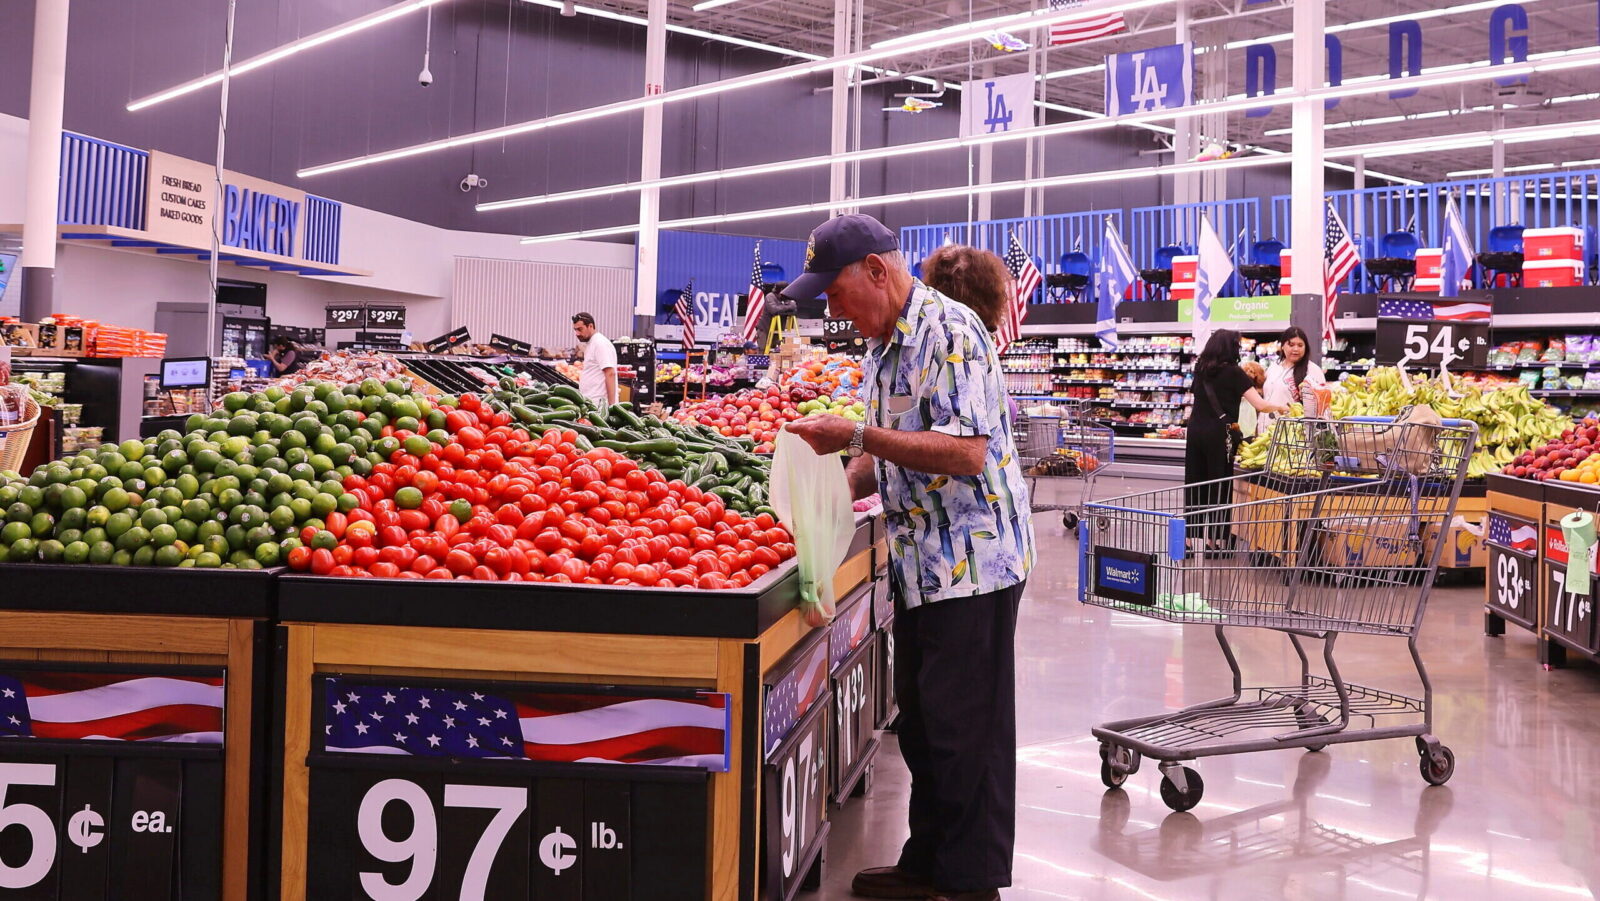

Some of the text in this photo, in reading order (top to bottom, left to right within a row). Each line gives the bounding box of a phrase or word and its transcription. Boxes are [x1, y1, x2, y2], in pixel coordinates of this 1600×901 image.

[1131, 53, 1168, 112] LA
[984, 82, 1012, 133] LA
[162, 176, 202, 193] FRESH BREAD
[161, 192, 206, 210] CUSTOM CAKES
[160, 207, 203, 225] BAKED GOODS
[222, 184, 300, 257] BAKERY
[1233, 300, 1270, 313] Organic
[332, 310, 359, 323] $297
[824, 320, 853, 334] $397
[1105, 566, 1131, 581] Walmart
[131, 810, 173, 833] ea.
[591, 822, 624, 849] lb.
